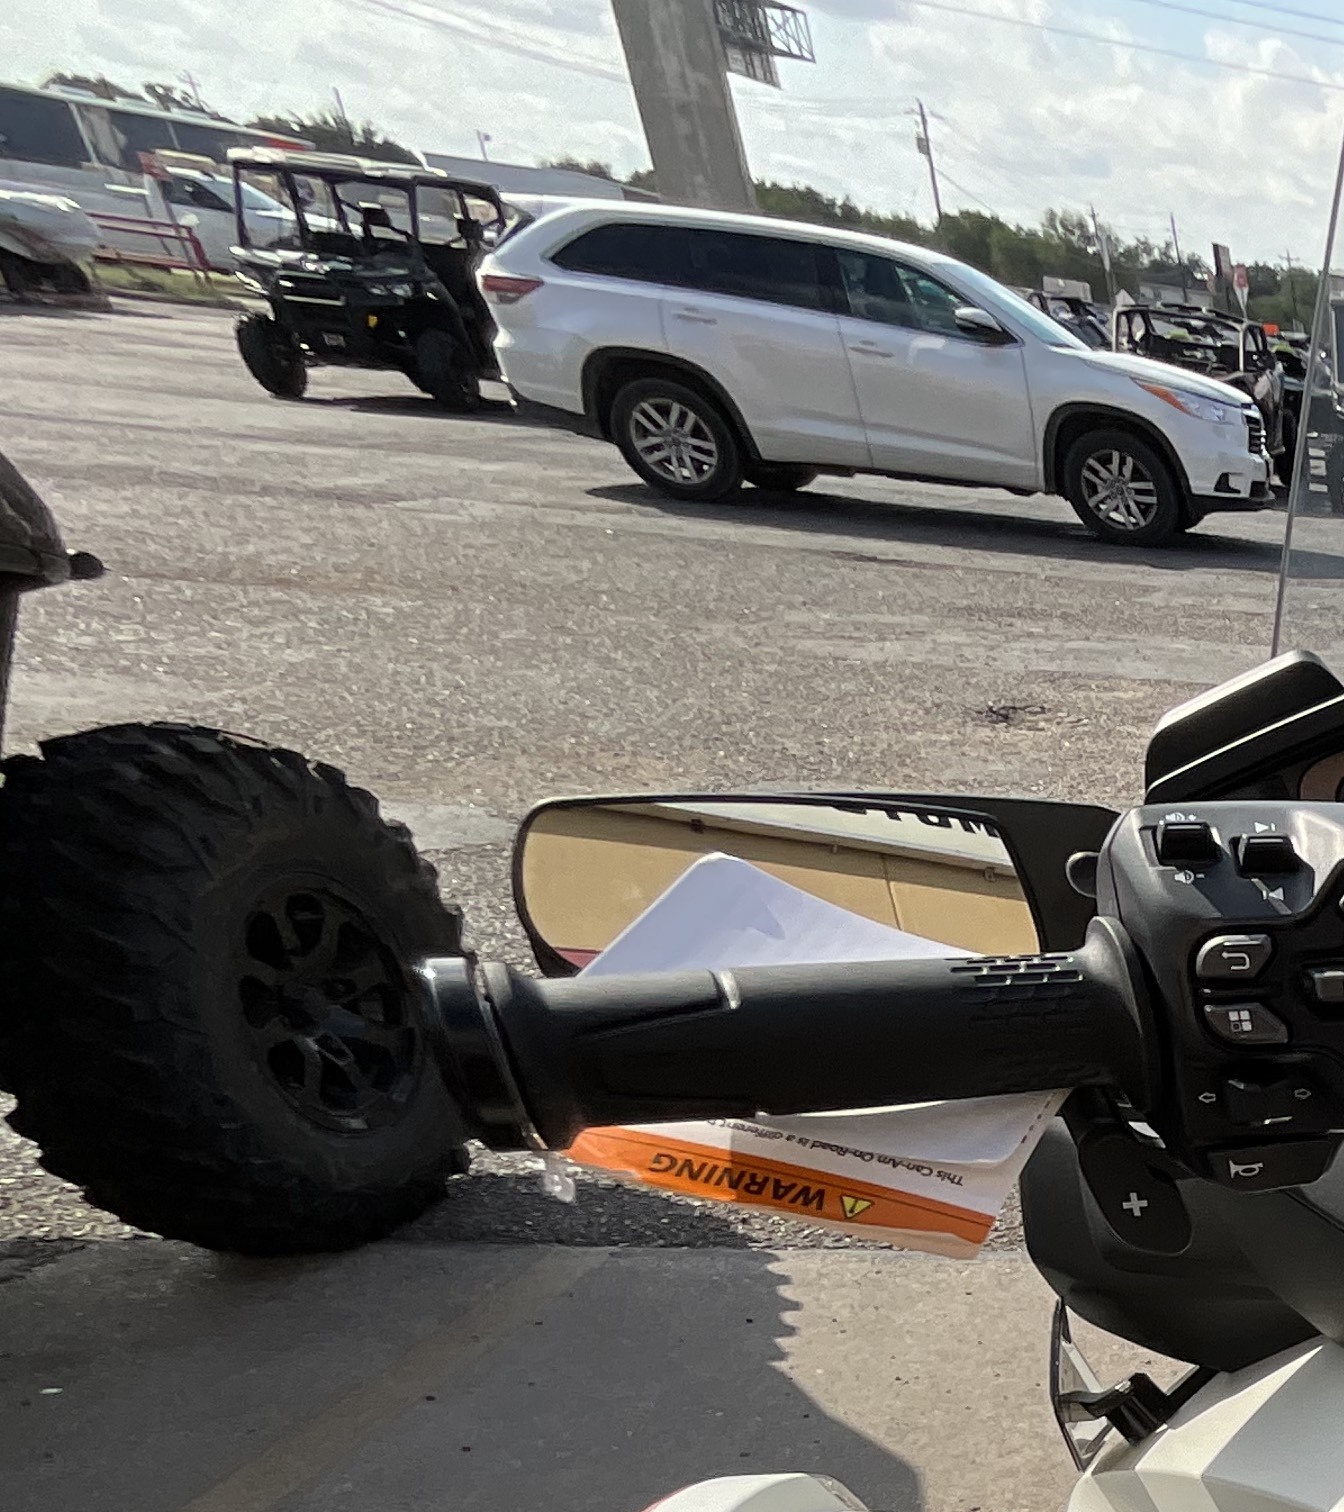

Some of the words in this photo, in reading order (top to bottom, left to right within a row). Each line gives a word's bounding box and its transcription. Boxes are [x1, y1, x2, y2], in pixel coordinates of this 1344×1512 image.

[810, 1140, 875, 1163] On-Road
[877, 1155, 934, 1177] Can-Am
[650, 1152, 827, 1212] WARNING
[936, 1169, 964, 1187] This
